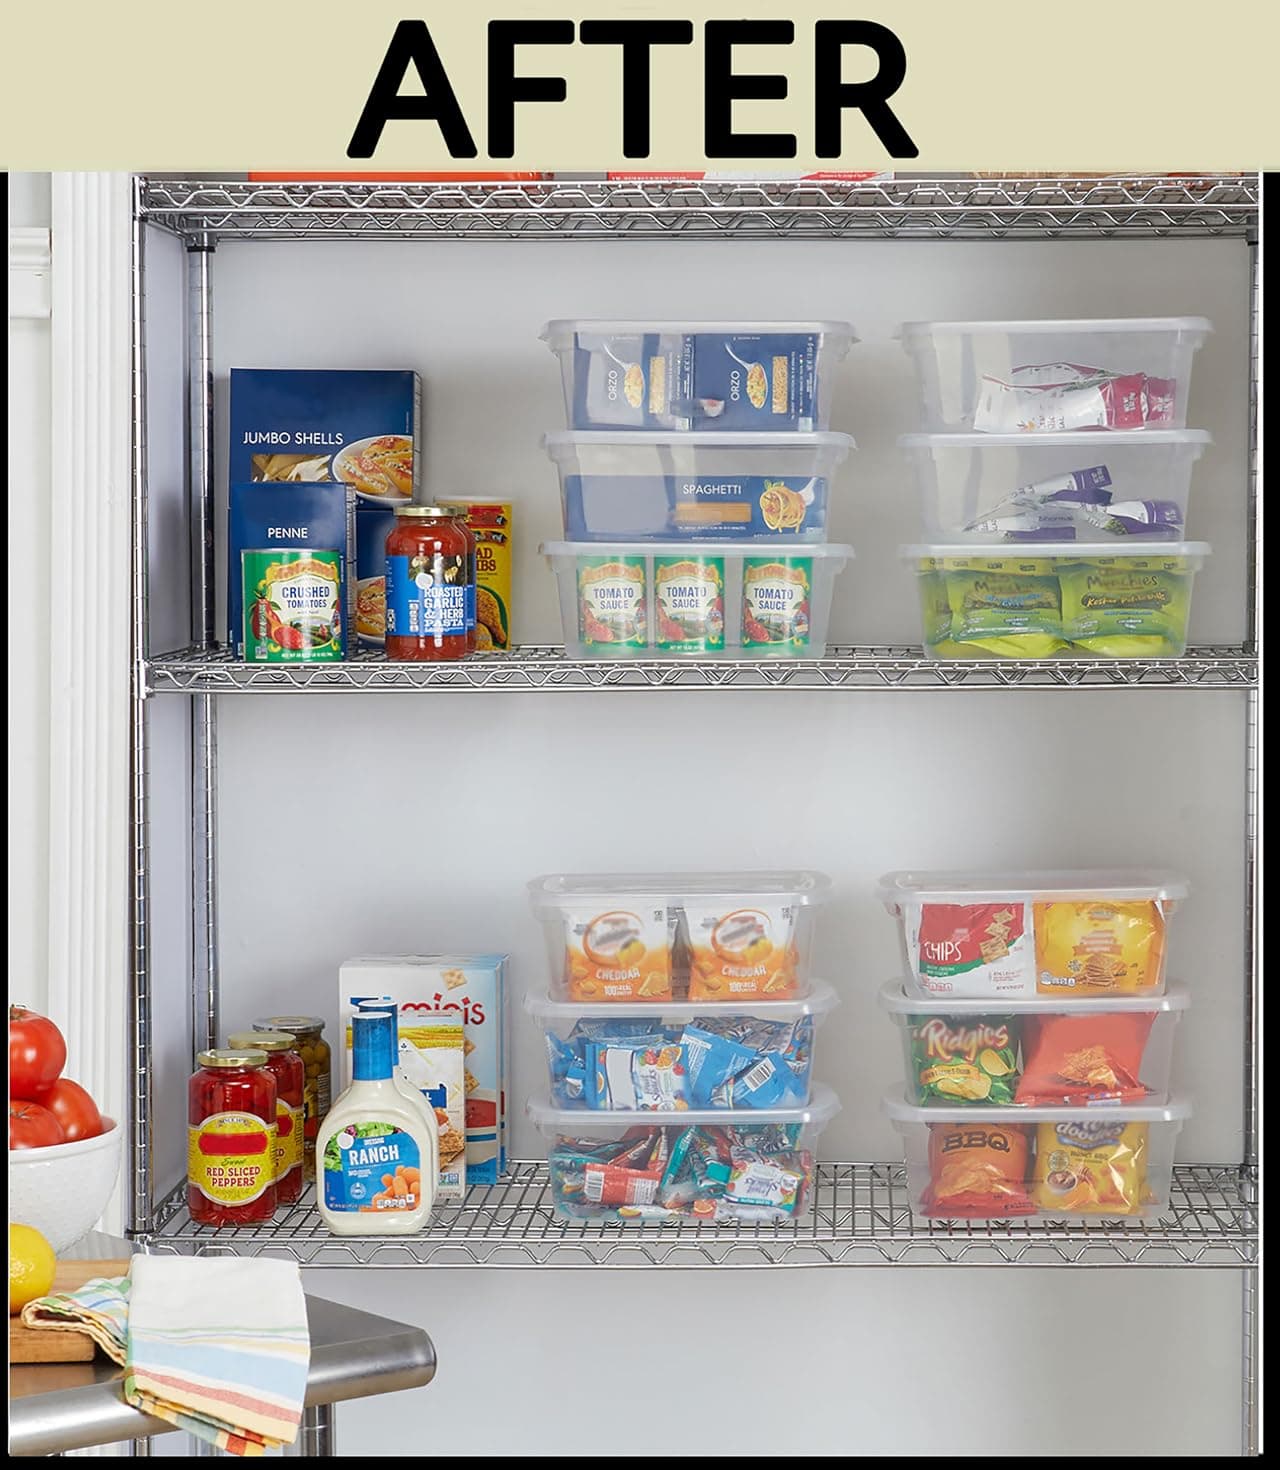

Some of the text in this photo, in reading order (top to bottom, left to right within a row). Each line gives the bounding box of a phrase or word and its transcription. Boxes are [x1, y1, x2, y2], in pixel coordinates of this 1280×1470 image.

[607, 371, 618, 400] ORZO
[730, 371, 740, 401] ORZO
[243, 432, 343, 445] JUMBO SHELLS
[683, 484, 741, 495] SPAGHETTI
[267, 528, 308, 539] PENNE
[282, 586, 330, 599] CRUSHED
[424, 587, 464, 598] ROASTED
[594, 588, 634, 599] TOMATO
[754, 588, 793, 600] TOMATO
[424, 598, 464, 608] GARLIC
[600, 600, 629, 609] SAUCE
[672, 599, 700, 608] SAUCE
[759, 601, 786, 610] SAUCE
[440, 609, 464, 619] HERB
[924, 941, 962, 961] CHIPS
[596, 967, 640, 981] CHEDDAR
[920, 1019, 1009, 1064] Ridgies
[942, 1131, 1010, 1153] BBQ
[349, 1145, 399, 1166] RANCH
[206, 1167, 260, 1177] RED SLICED
[212, 1177, 255, 1187] PEPPERS
